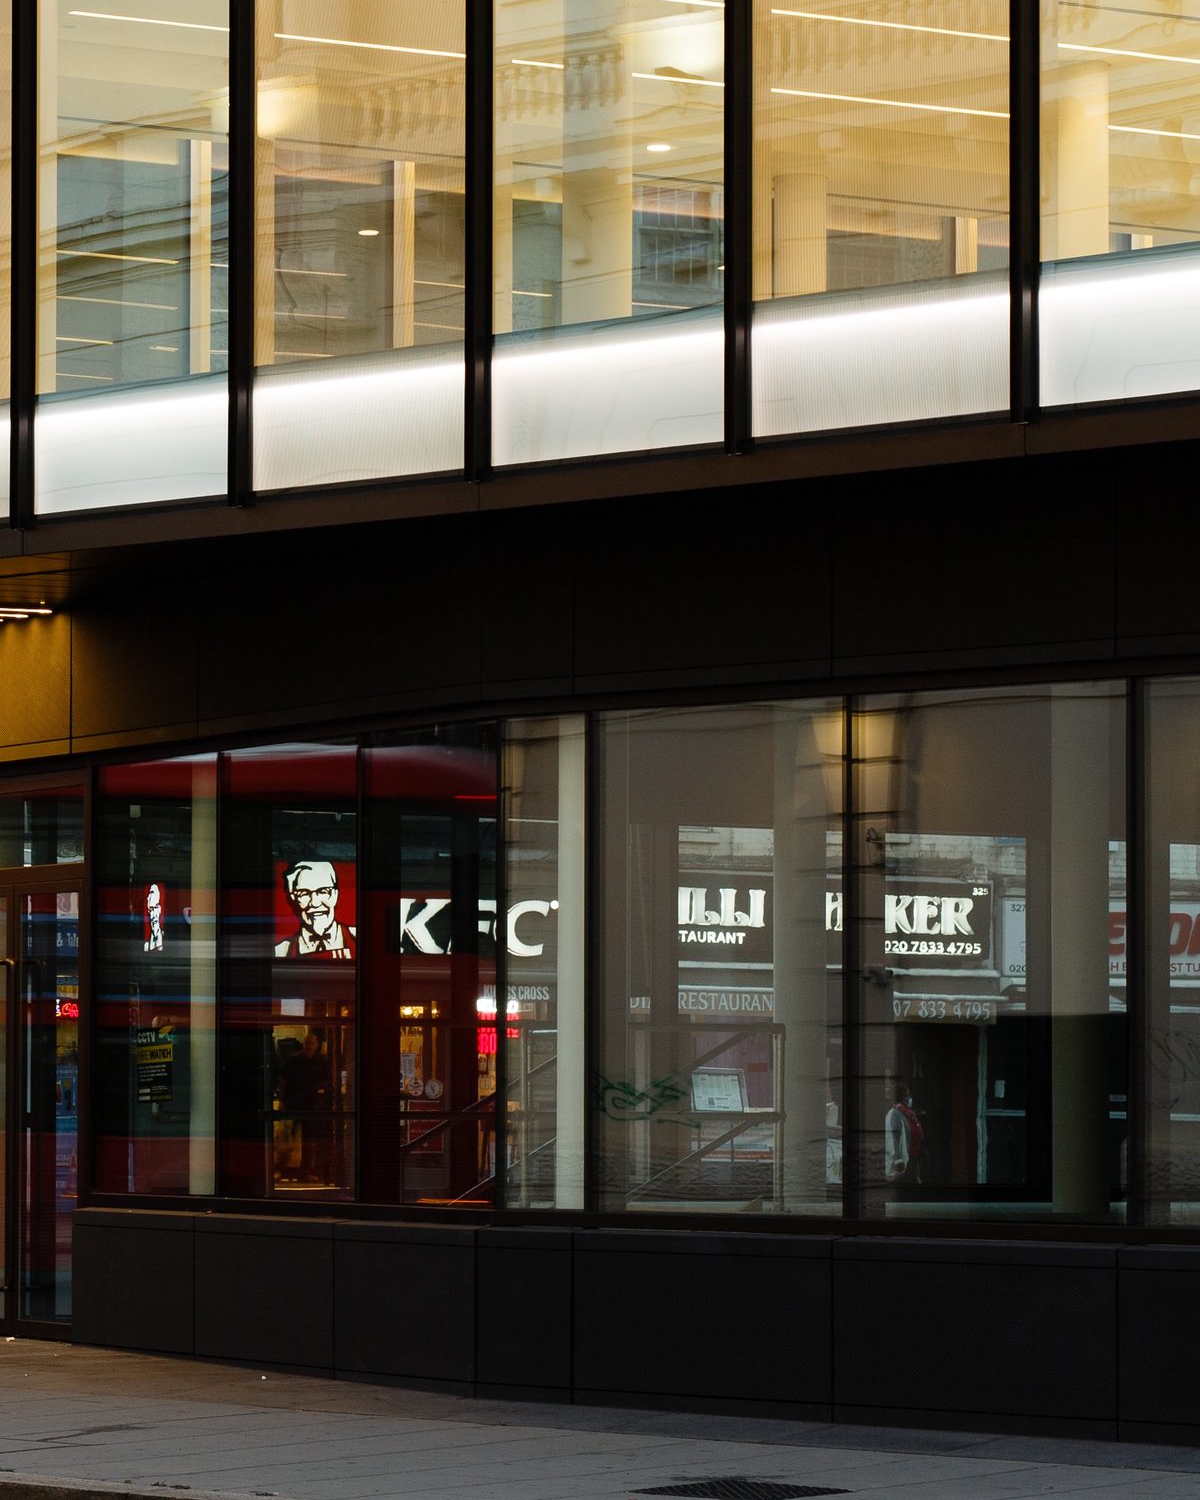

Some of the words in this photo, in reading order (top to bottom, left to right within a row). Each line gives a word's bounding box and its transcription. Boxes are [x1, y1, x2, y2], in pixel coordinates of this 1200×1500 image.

[885, 940, 908, 953] 020
[911, 940, 944, 953] 7833
[946, 942, 982, 955] 4795
[518, 985, 550, 1000] CROSS
[678, 992, 773, 1012] RESTAURAN
[917, 1001, 946, 1019] 833
